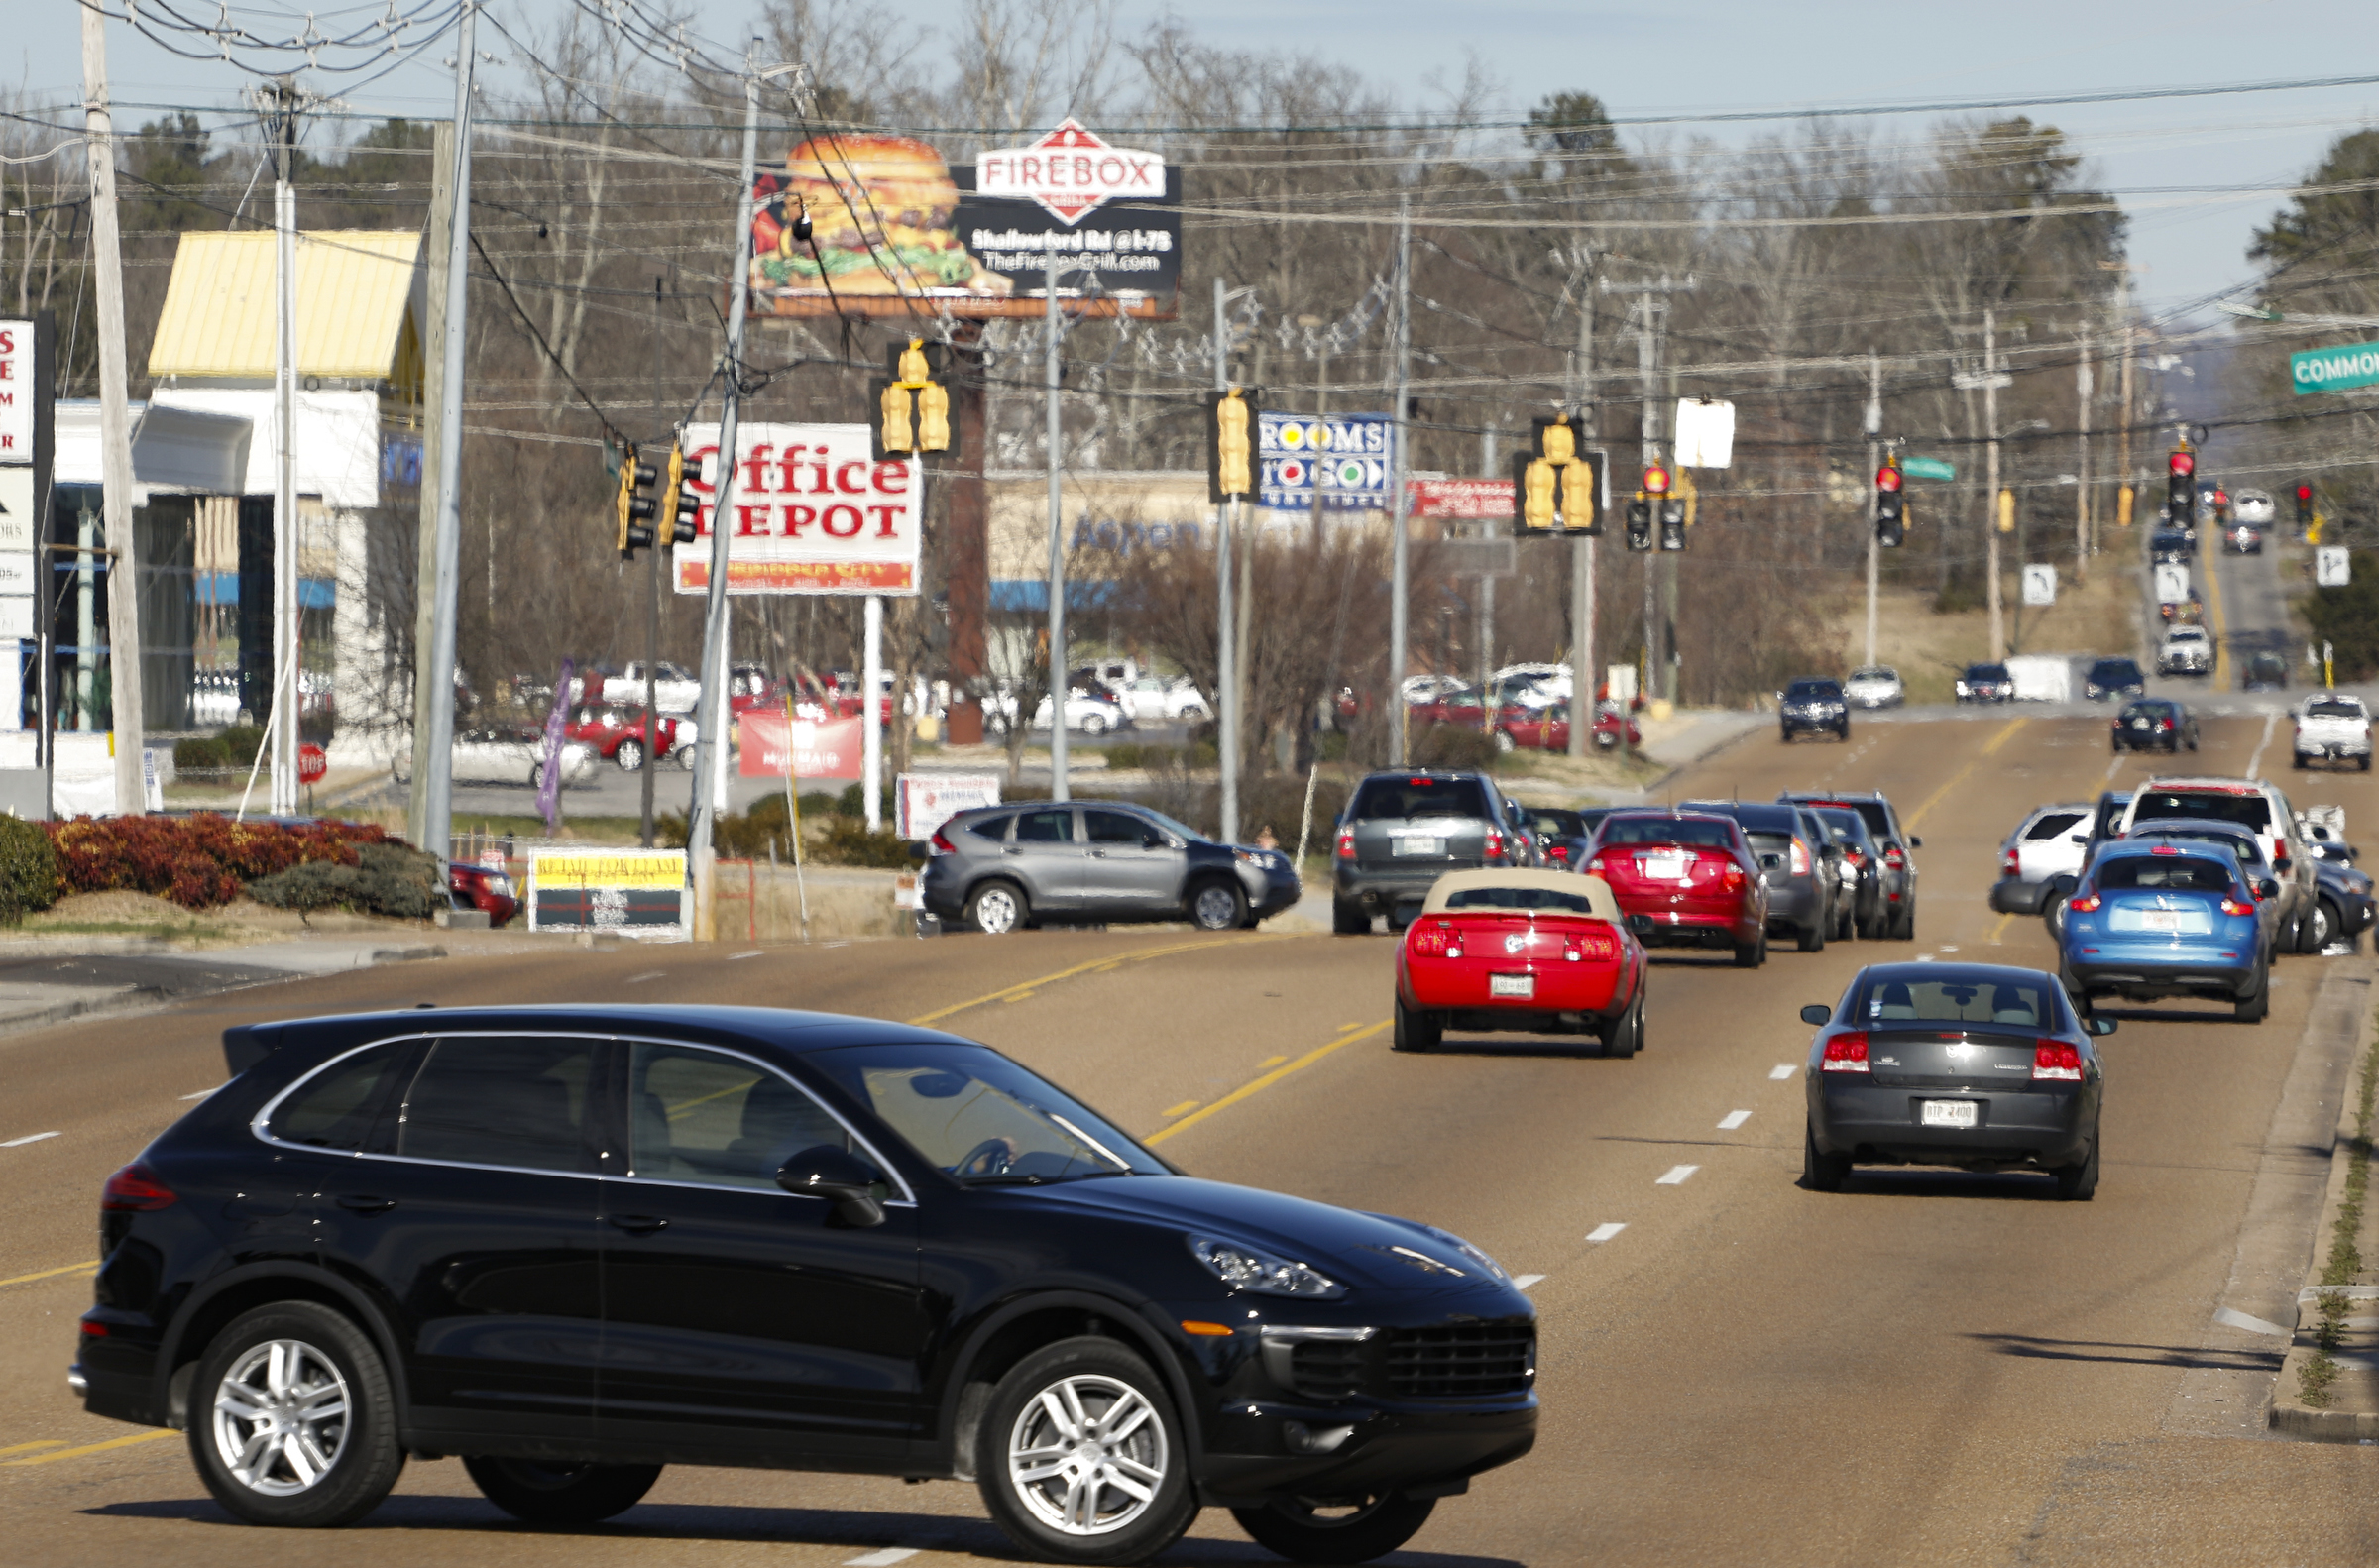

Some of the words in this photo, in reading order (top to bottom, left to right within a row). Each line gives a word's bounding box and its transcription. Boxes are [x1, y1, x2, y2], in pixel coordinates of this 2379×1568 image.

[985, 155, 1152, 187] FIREBOX
[1259, 422, 1384, 452] ROOMS
[688, 443, 909, 493] Office
